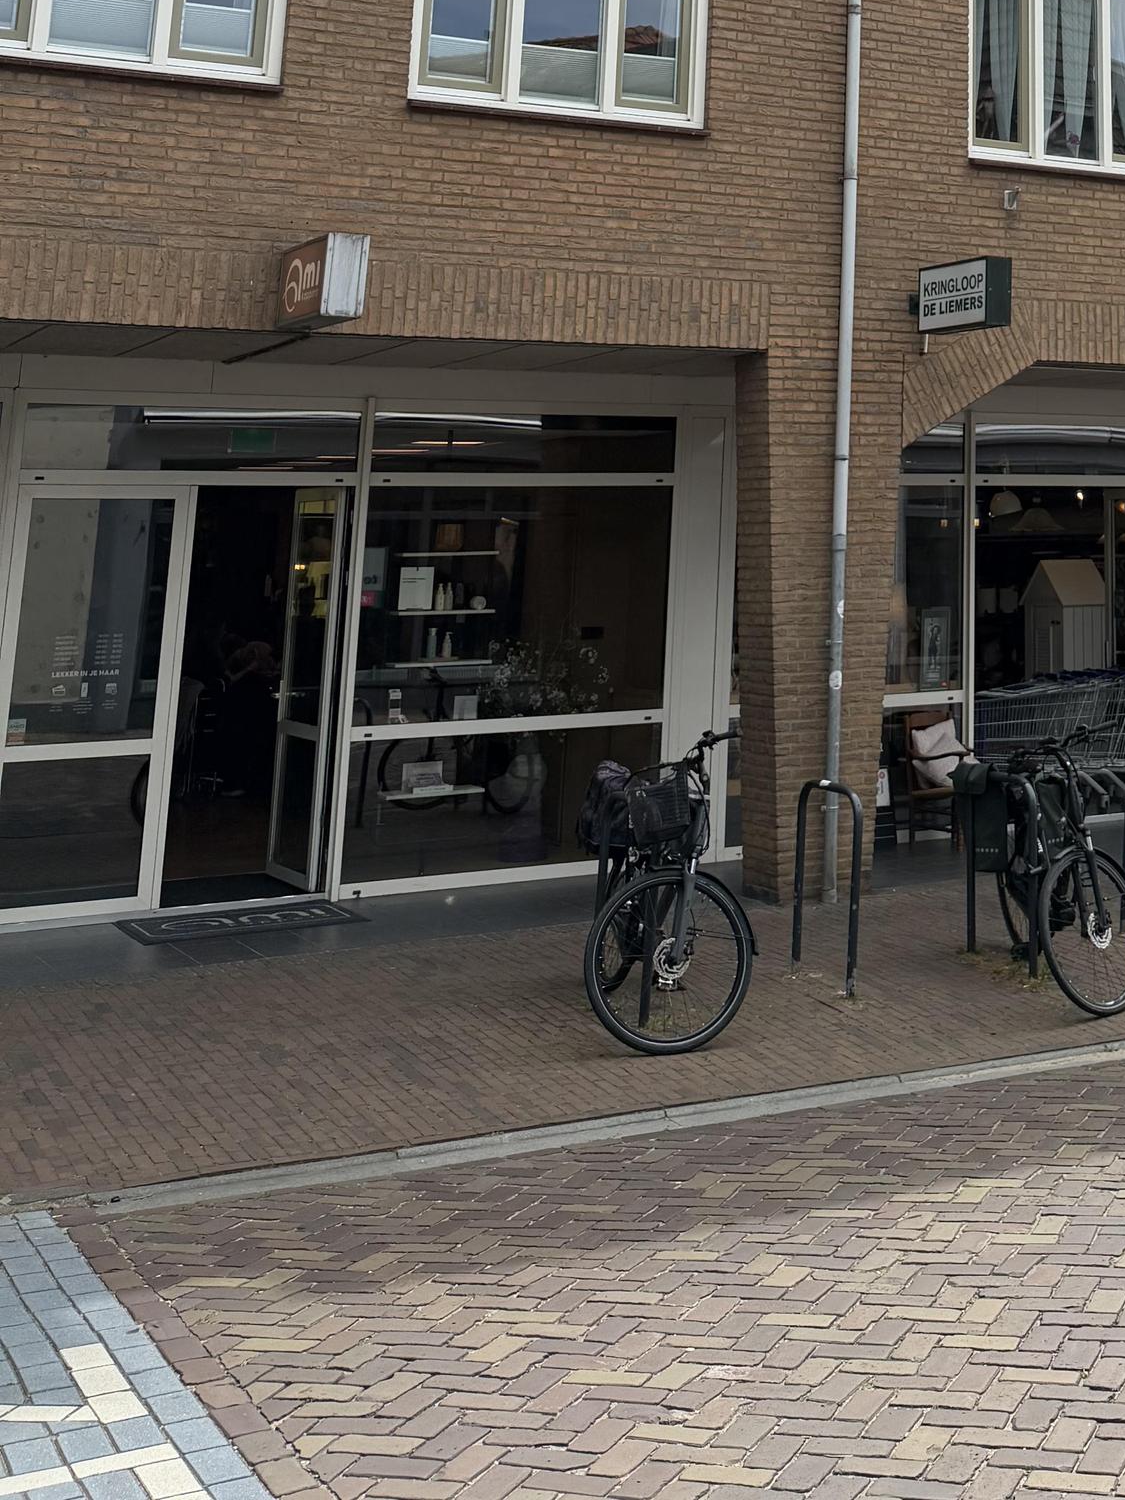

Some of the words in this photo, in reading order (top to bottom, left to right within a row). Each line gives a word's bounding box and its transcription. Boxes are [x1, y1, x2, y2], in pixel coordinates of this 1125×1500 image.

[923, 273, 984, 298] KRINGLOOP
[923, 303, 937, 317] DE
[939, 295, 984, 315] LIEMERS
